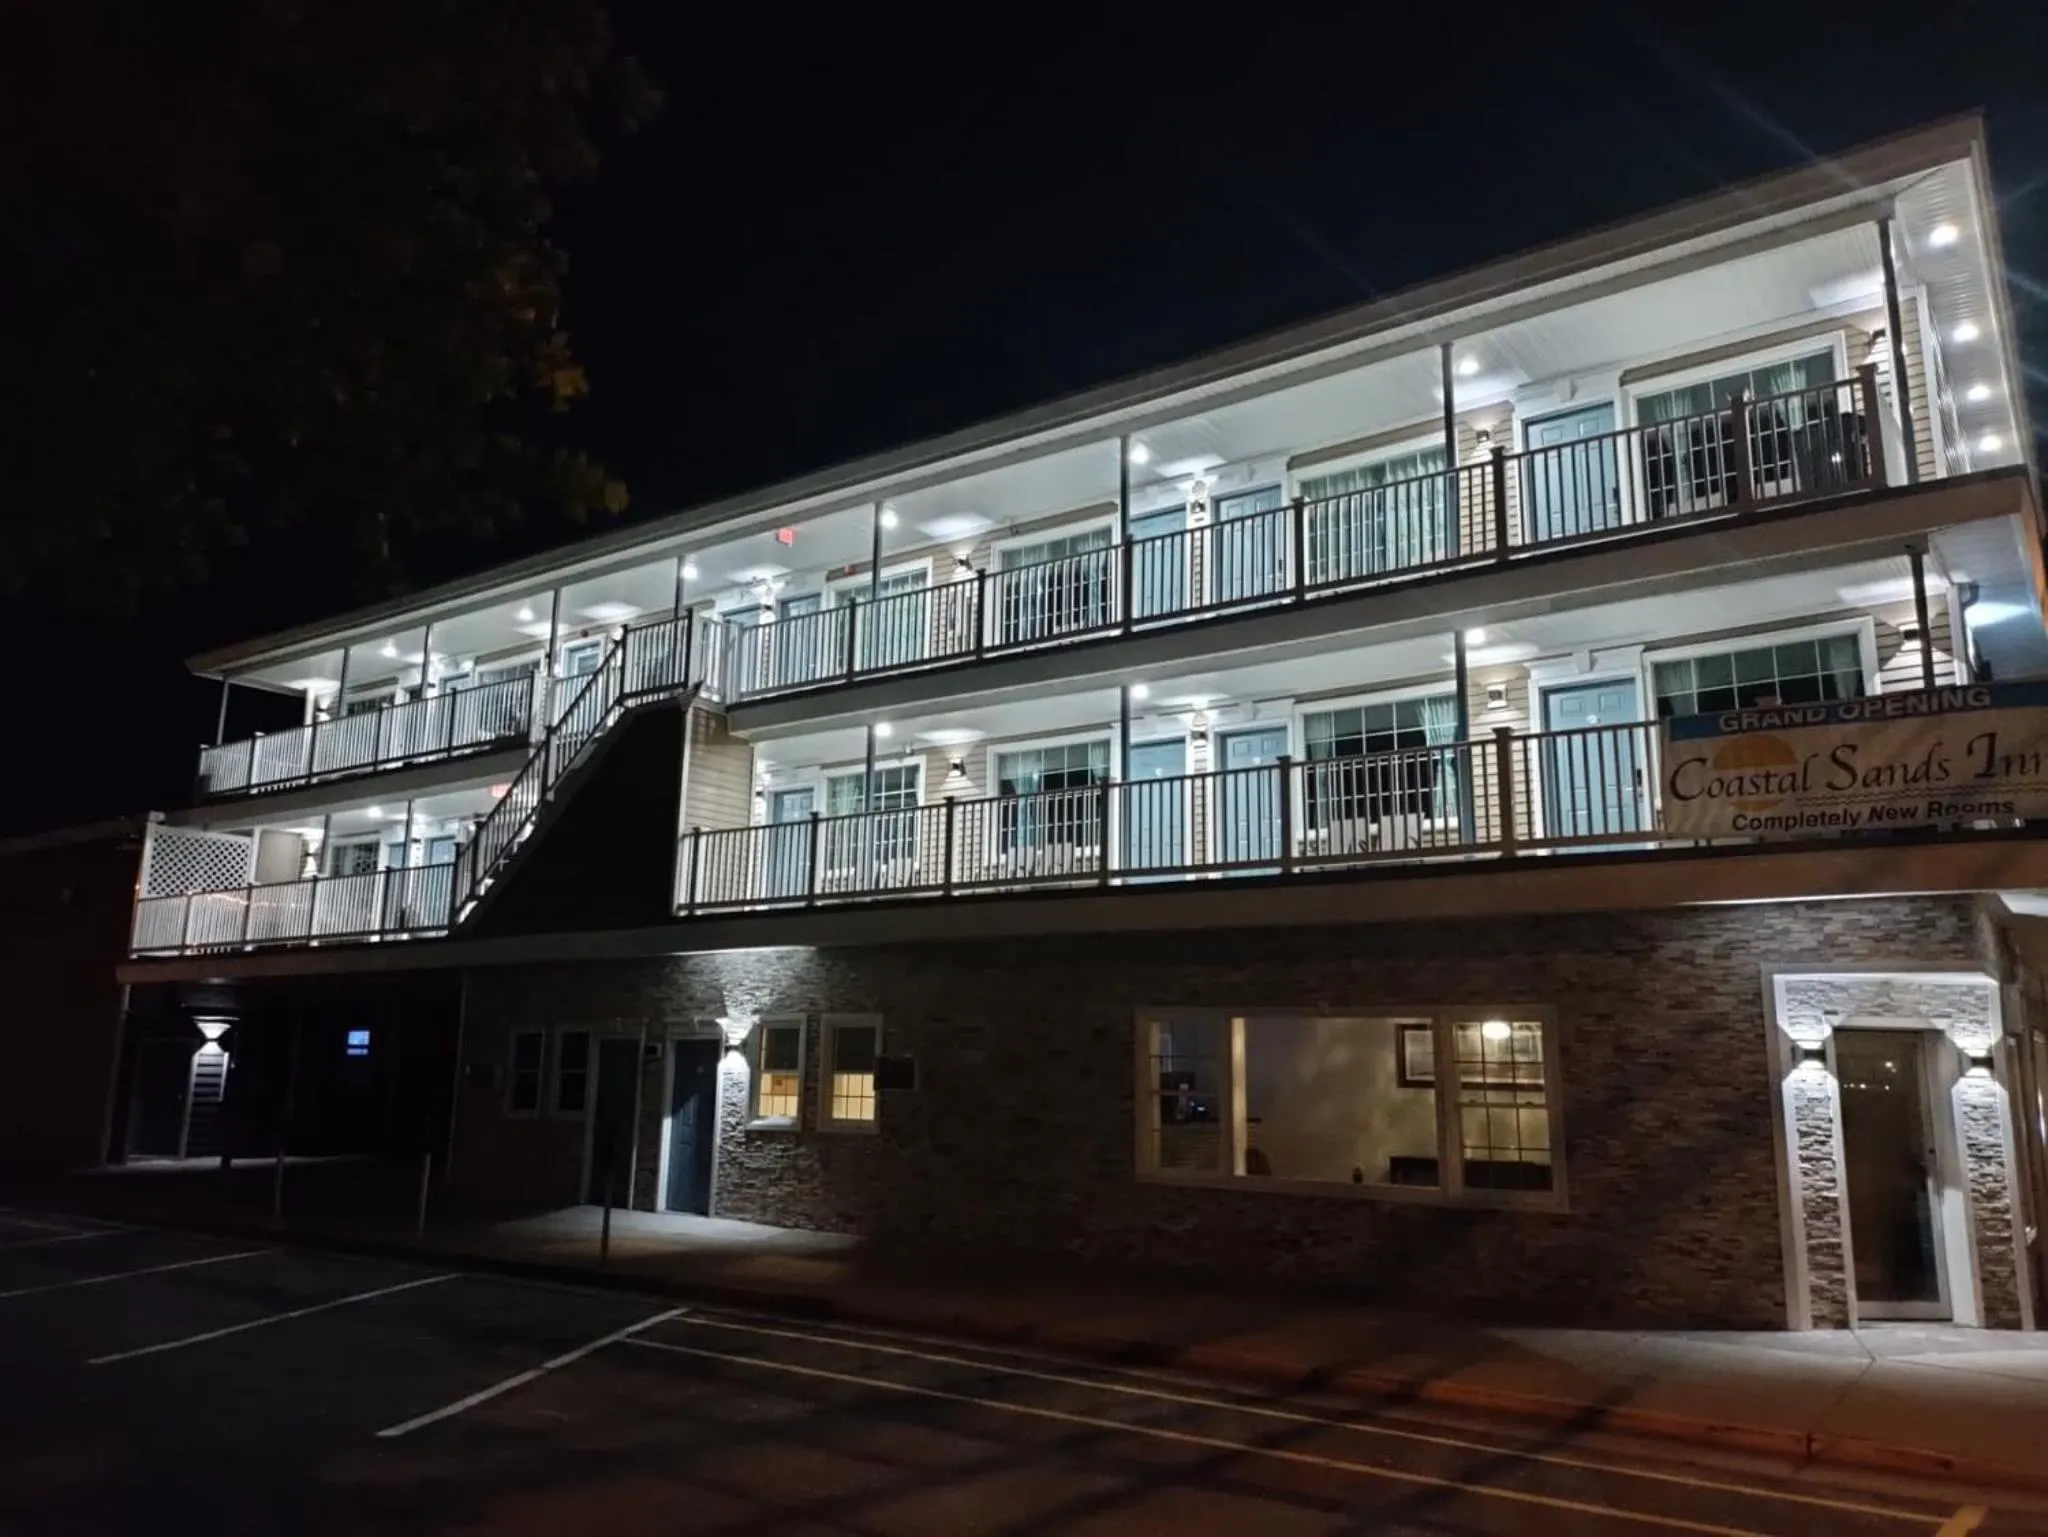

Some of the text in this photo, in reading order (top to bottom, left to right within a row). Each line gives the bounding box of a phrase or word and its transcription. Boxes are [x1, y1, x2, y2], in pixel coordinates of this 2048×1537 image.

[1718, 687, 1992, 732] GRAND OPENING
[1670, 753, 1819, 801] Coastal
[1826, 741, 1951, 792] Sands
[1732, 799, 2015, 832] Completely New Rooms
